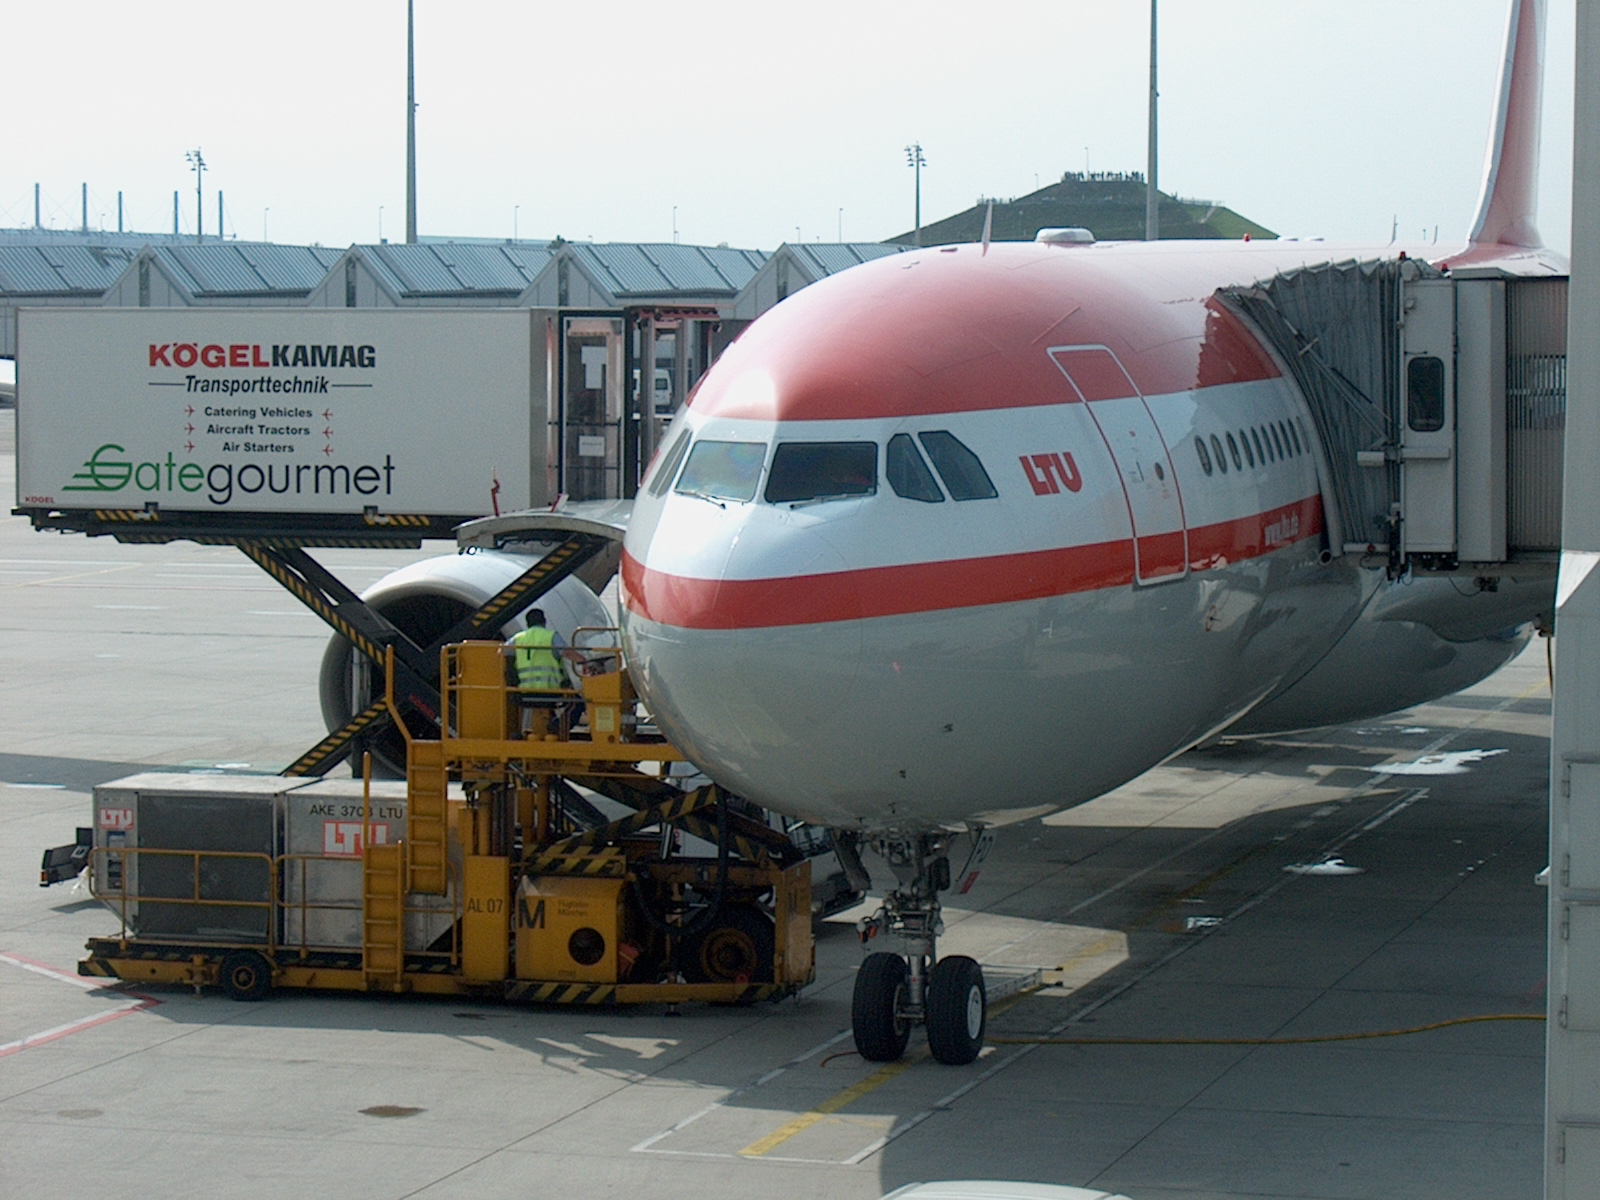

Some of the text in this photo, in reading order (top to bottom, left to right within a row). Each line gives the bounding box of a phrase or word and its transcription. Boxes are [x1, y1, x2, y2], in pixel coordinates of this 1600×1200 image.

[185, 375, 329, 396] Transporttechnik
[204, 406, 313, 419] Catering Vehicles
[207, 424, 310, 436] Aircraft Tractors
[222, 442, 294, 453] Air Starters
[1019, 452, 1082, 496] LTU
[100, 809, 133, 829] LTU
[309, 804, 335, 816] AKE
[379, 807, 403, 819] LTU
[466, 897, 503, 913] AL 07
[518, 899, 545, 929] M
